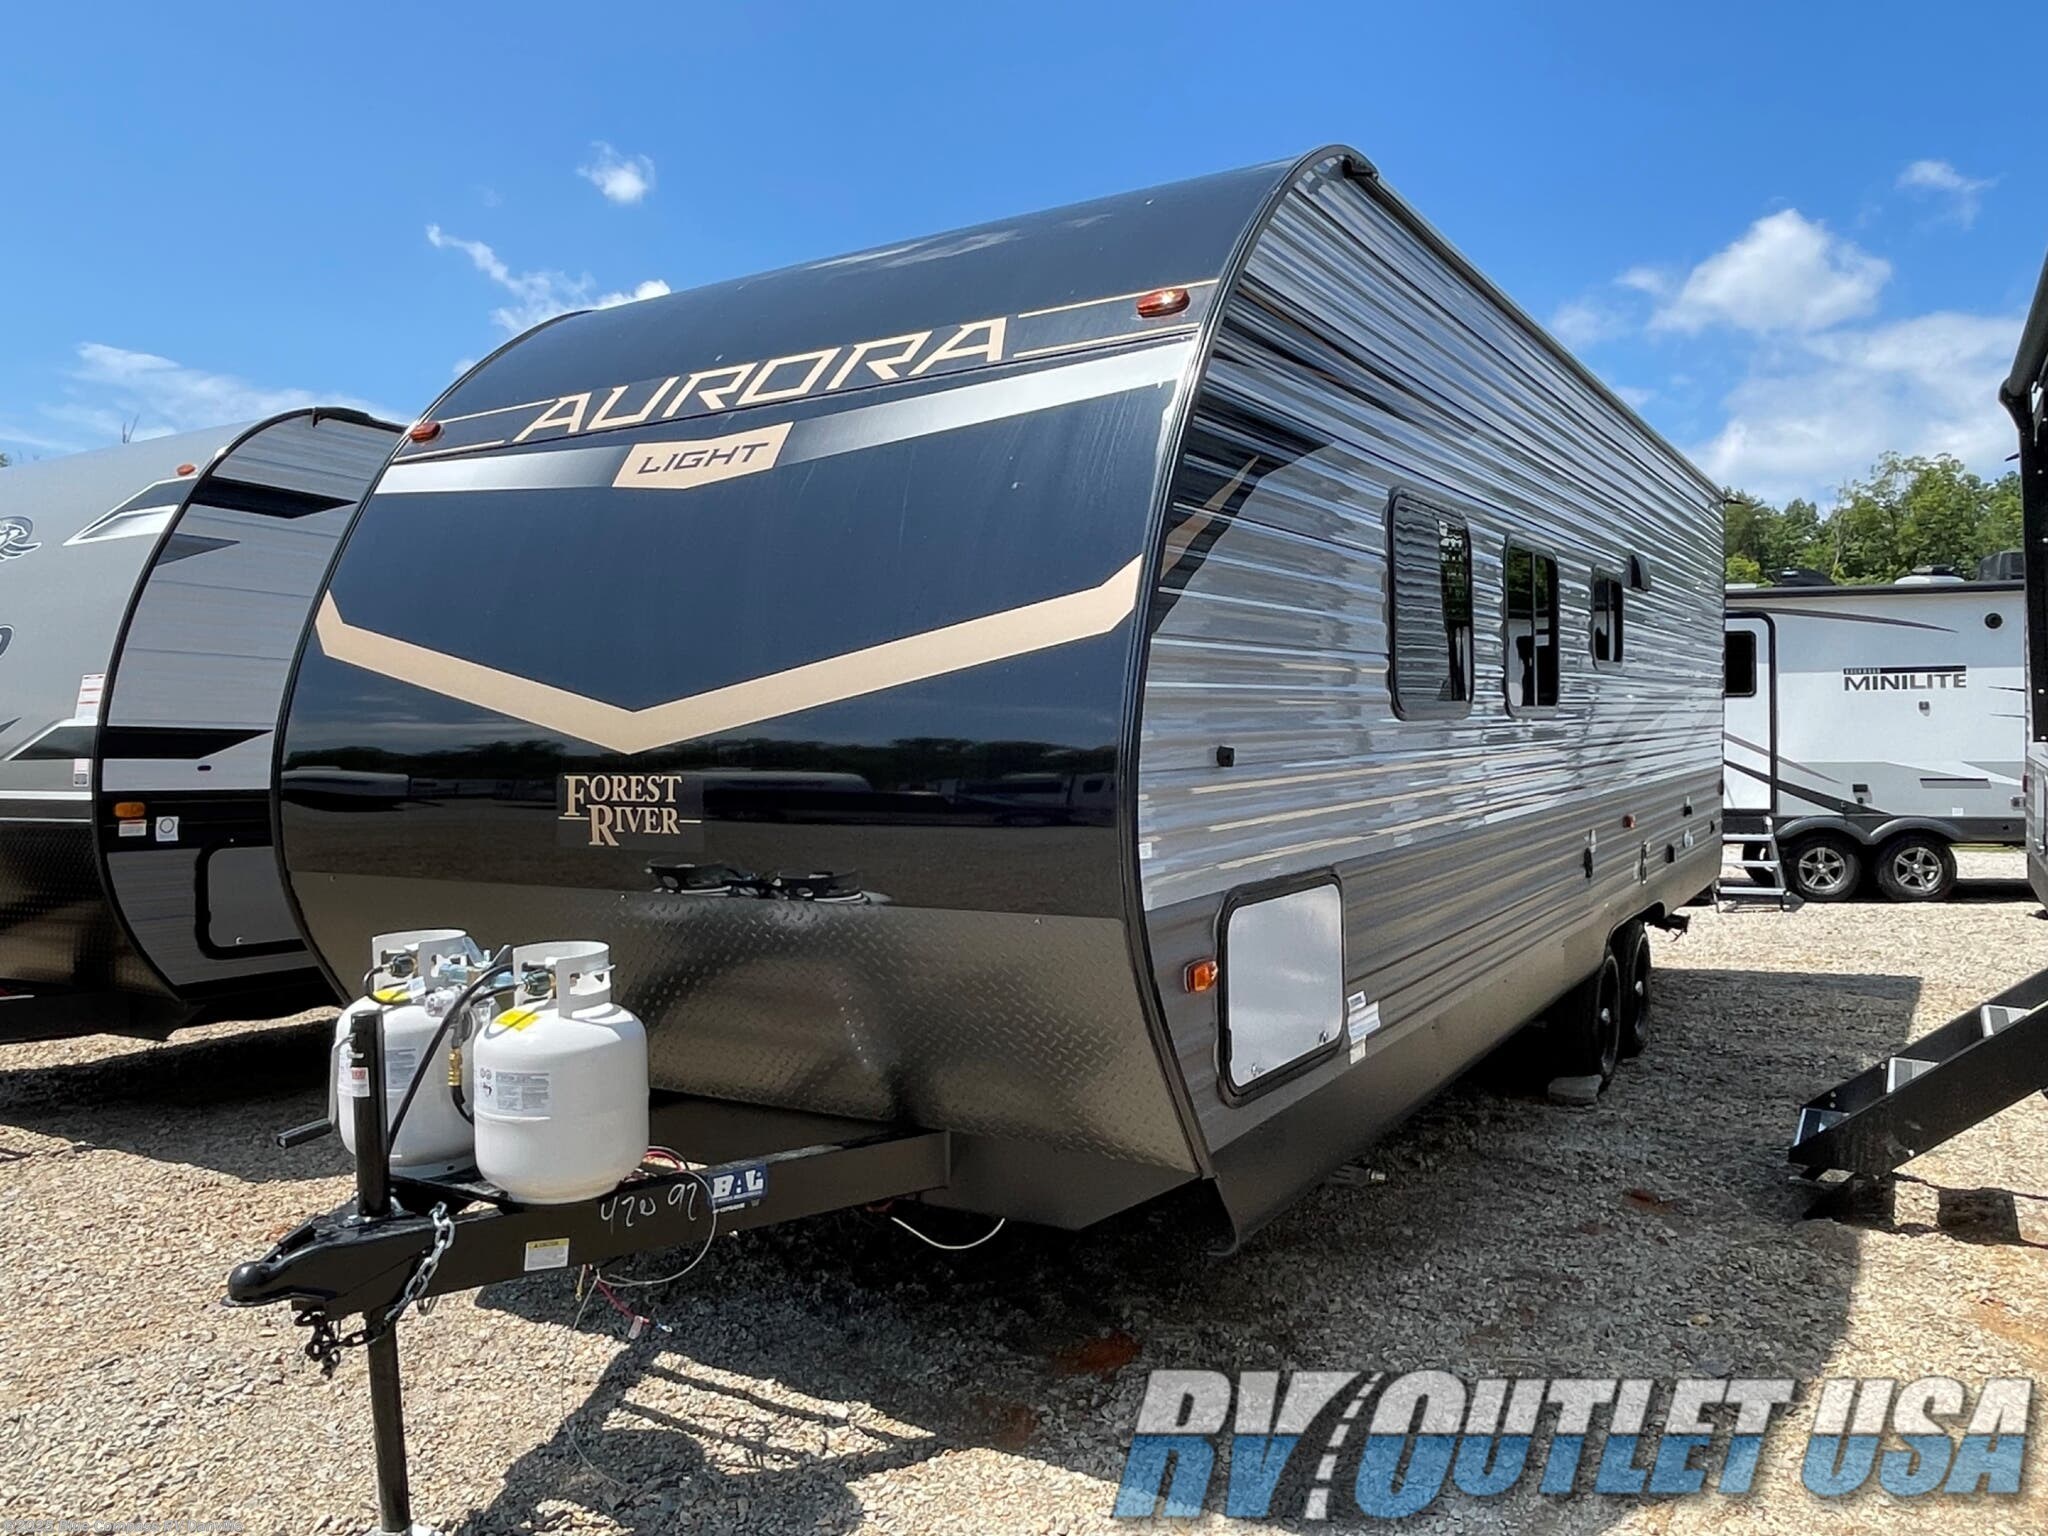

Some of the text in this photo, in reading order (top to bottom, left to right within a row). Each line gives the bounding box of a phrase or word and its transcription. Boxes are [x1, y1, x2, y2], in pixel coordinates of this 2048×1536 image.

[513, 316, 1008, 442] AURORA
[637, 442, 770, 475] LIGHT
[1844, 673, 1967, 691] MINILITE
[564, 775, 683, 816] FOREST
[586, 804, 681, 847] RIVER
